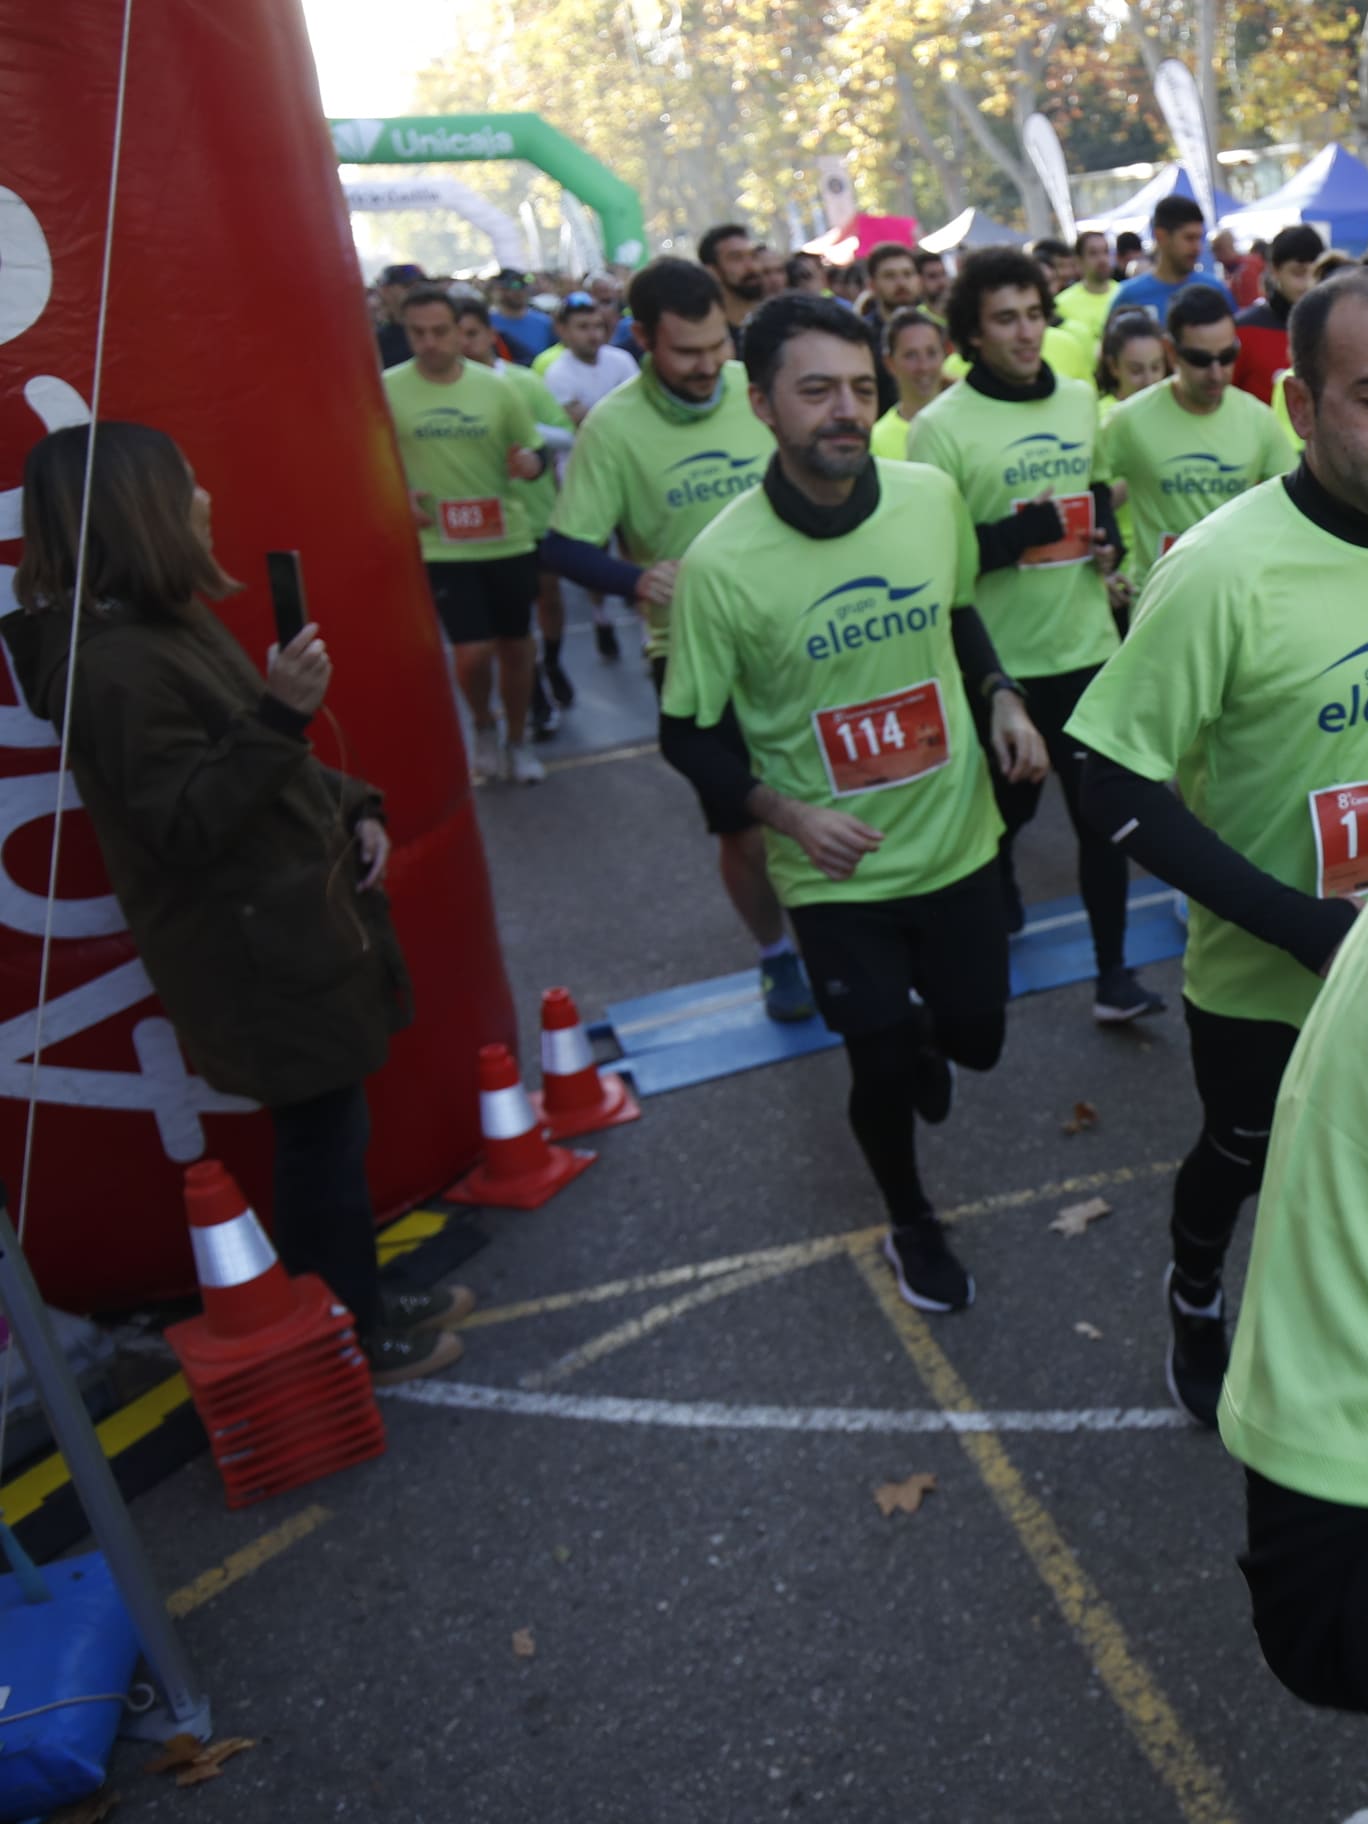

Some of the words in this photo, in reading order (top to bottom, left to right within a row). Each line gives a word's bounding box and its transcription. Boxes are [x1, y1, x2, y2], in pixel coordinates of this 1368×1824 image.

[391, 125, 514, 158] Unicaja
[806, 603, 940, 660] elecnor
[836, 710, 905, 761] 114
